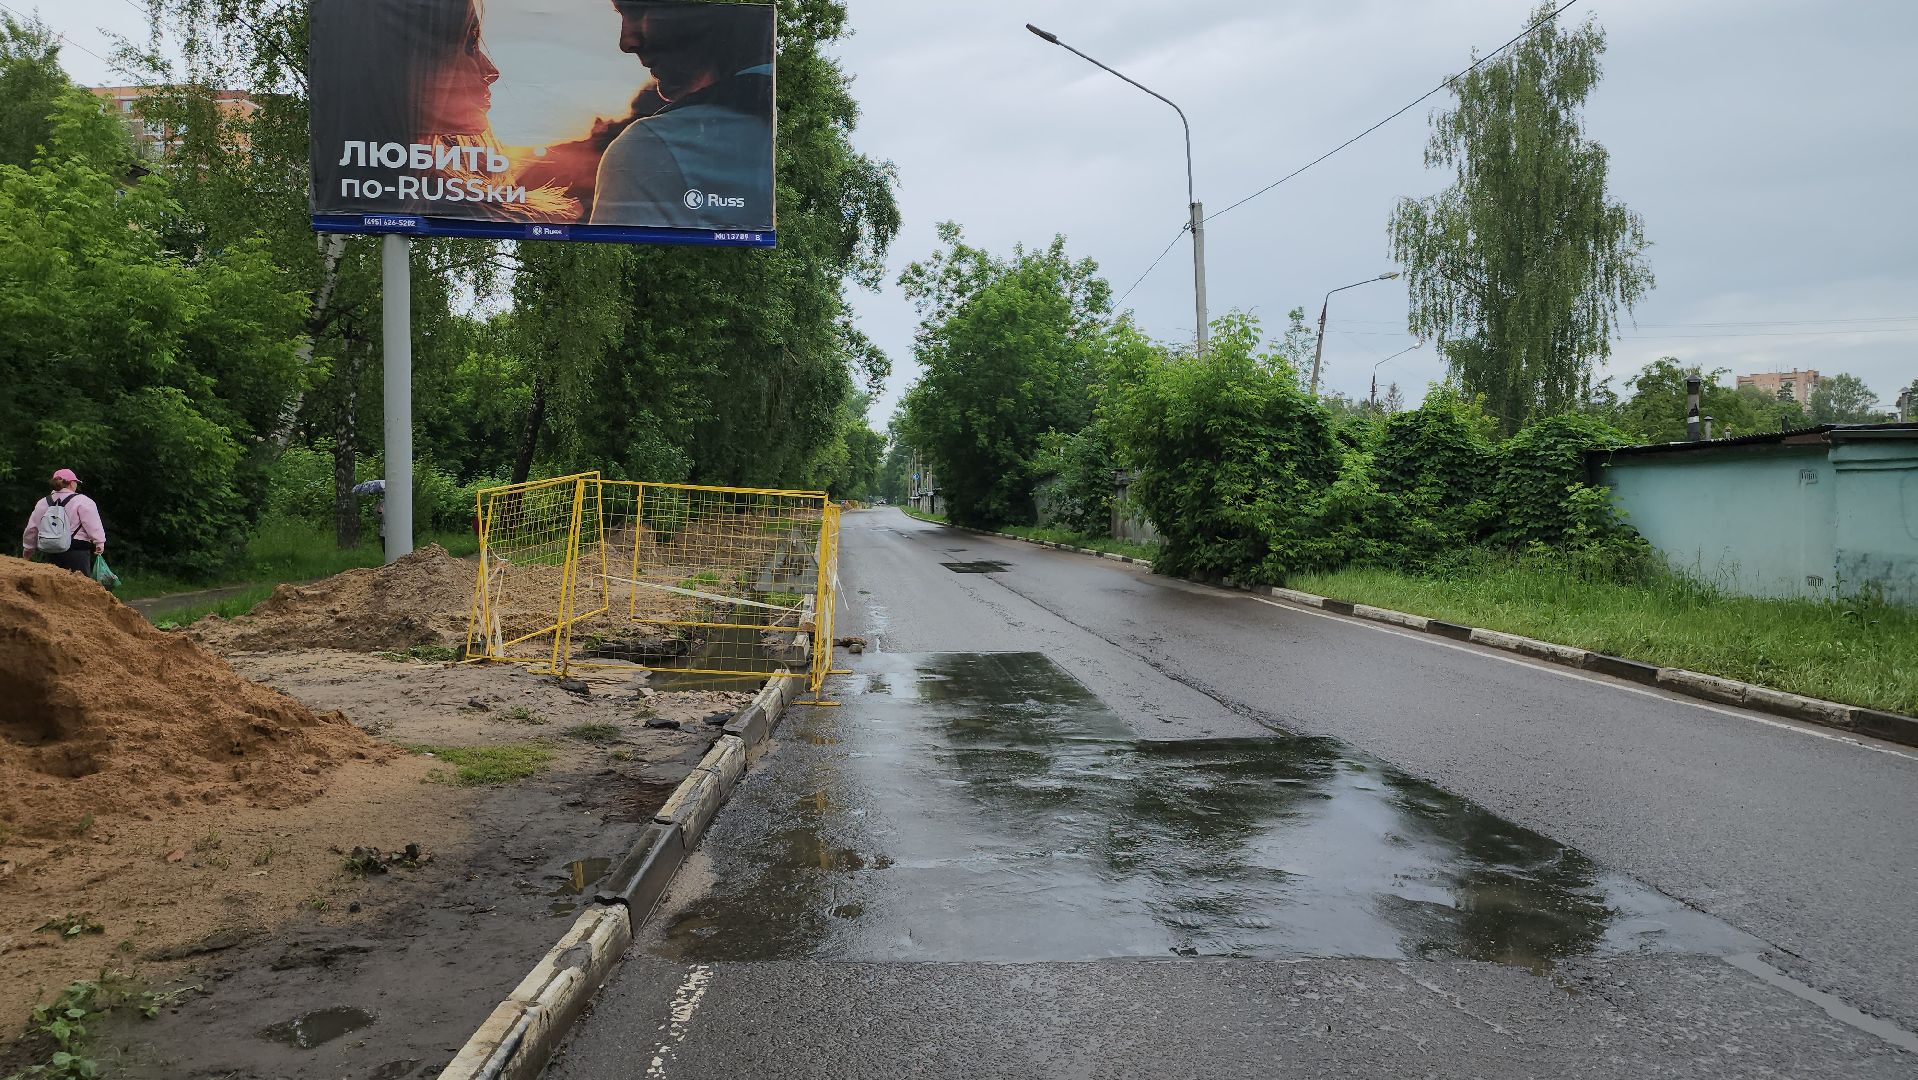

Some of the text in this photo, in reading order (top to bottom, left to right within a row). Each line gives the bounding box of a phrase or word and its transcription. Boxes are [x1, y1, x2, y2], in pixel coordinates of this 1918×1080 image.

[338, 140, 510, 173] ЛЮБИТЬ
[341, 175, 527, 204] по-RUSSки
[707, 193, 745, 208] Russ
